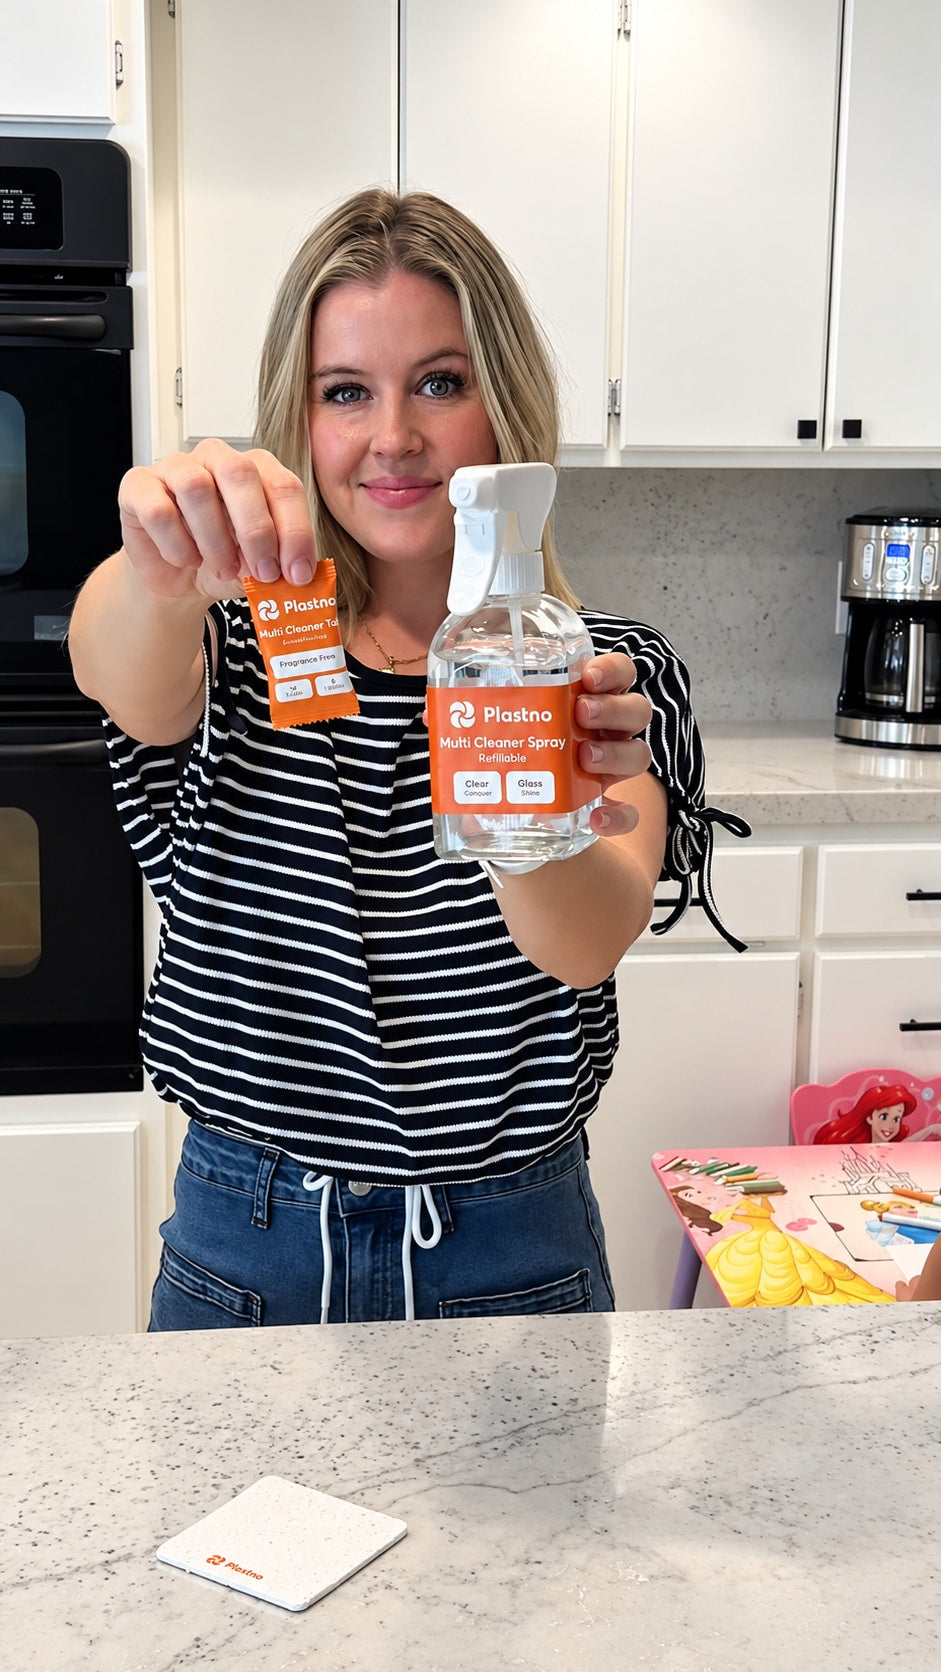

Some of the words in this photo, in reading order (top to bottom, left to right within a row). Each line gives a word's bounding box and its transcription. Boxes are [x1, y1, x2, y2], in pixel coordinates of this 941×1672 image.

[283, 597, 337, 614] Plastno
[259, 627, 283, 639] Multi
[285, 622, 325, 635] Cleaner
[280, 656, 318, 668] Fragrance
[483, 706, 553, 723] Plastno
[439, 737, 471, 749] Multi
[474, 737, 524, 749] Cleaner
[527, 737, 566, 751] Spray
[478, 753, 527, 763] Refillable
[465, 780, 490, 788] Clear
[517, 779, 543, 788] Glass
[521, 789, 540, 797] Shine
[225, 1562, 264, 1580] Plastno
